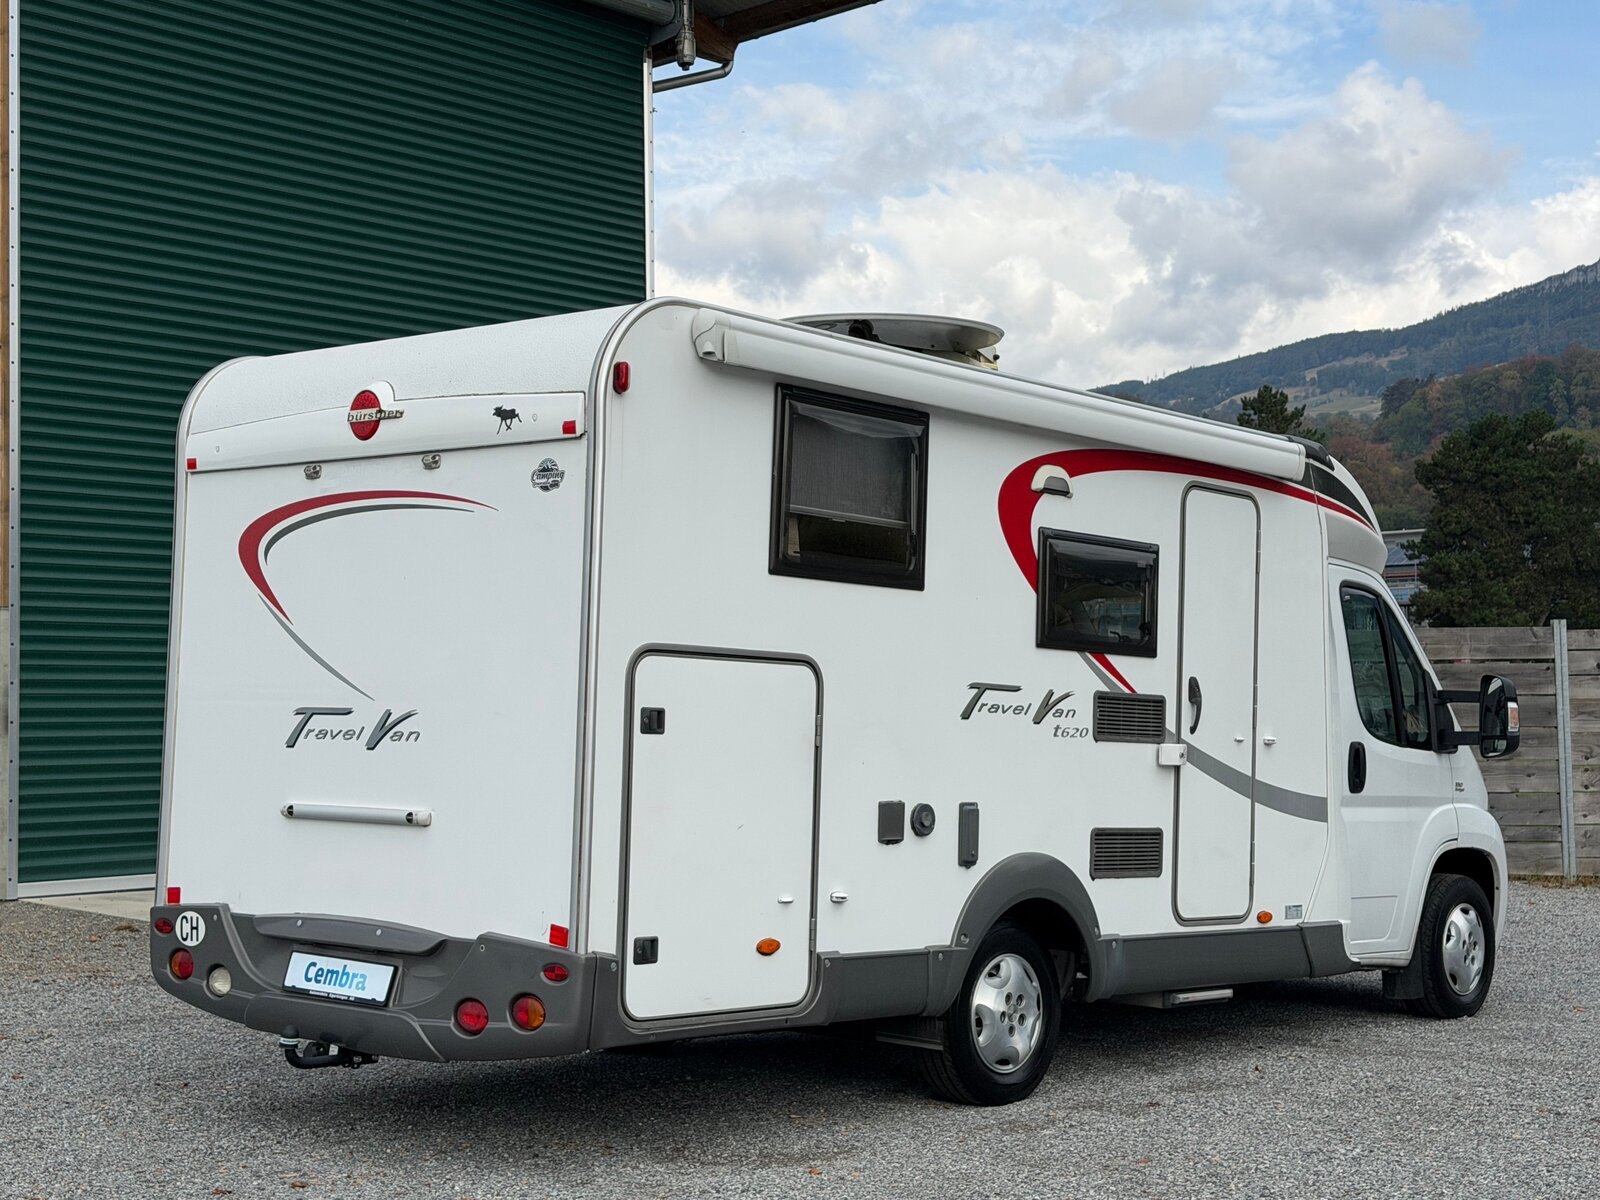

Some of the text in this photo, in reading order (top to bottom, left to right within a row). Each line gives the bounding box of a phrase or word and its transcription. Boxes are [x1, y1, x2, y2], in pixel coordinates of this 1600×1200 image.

[347, 409, 404, 422] bürstner
[531, 470, 565, 482] Camping
[960, 682, 1077, 724] Travel Van
[285, 707, 421, 751] Travel Van
[1053, 725, 1089, 738] t620
[180, 915, 199, 942] CH
[304, 961, 367, 991] Cembra
